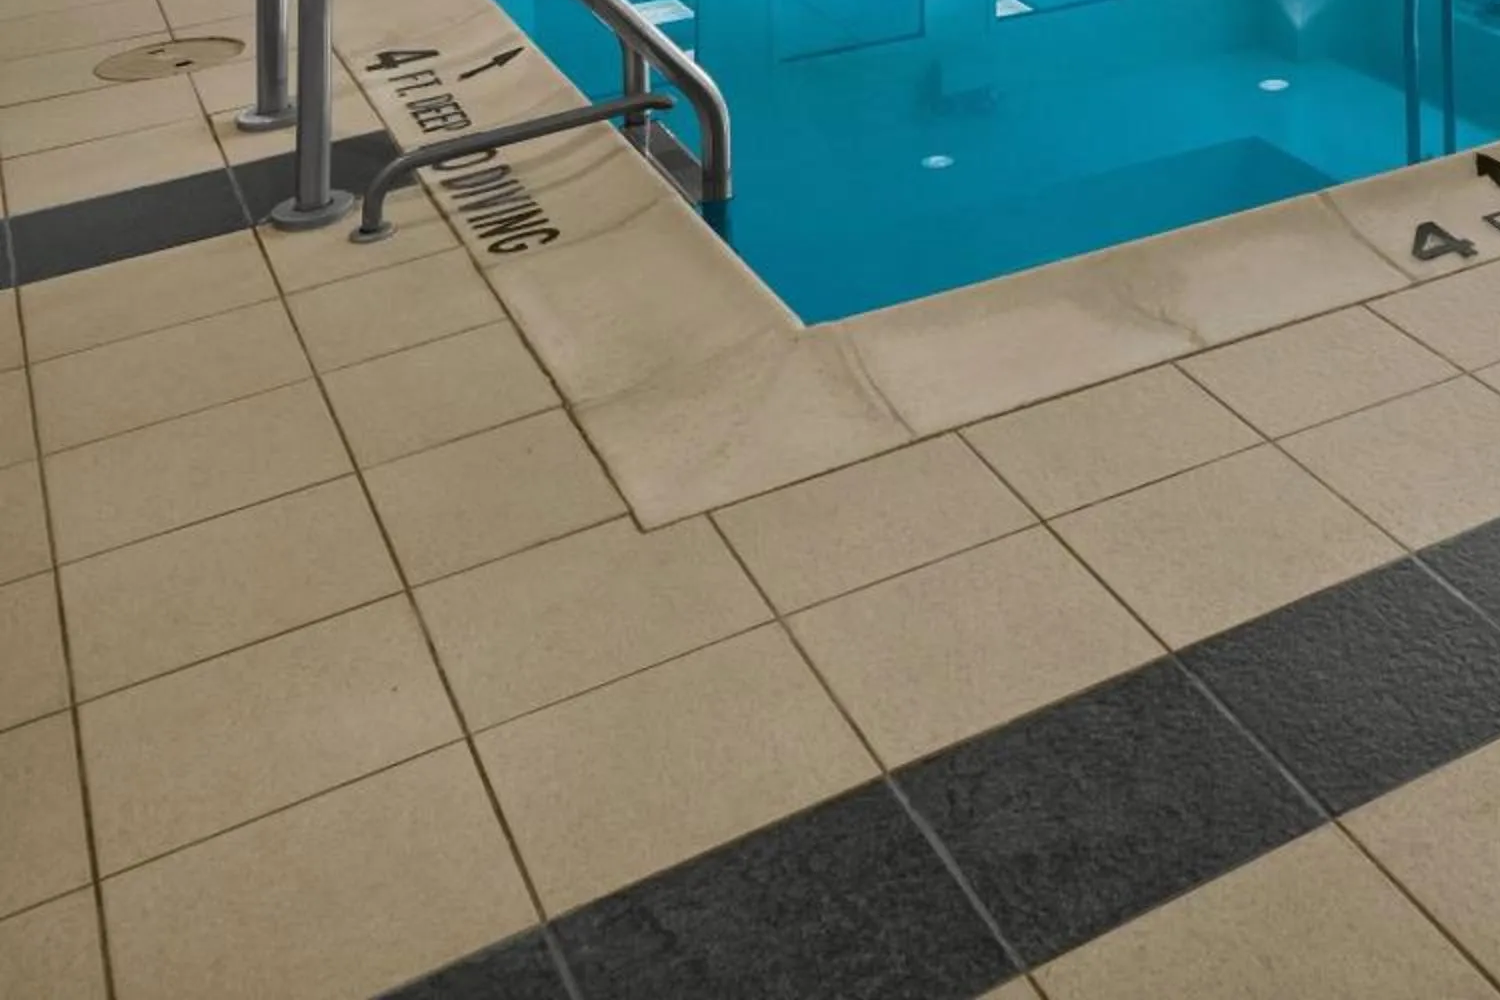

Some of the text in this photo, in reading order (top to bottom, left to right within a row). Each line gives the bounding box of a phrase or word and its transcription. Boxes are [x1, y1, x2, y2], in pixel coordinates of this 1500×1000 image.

[366, 49, 440, 73] 4
[406, 94, 473, 134] DEEP
[440, 163, 561, 254] DIVING
[1410, 220, 1479, 264] 4
